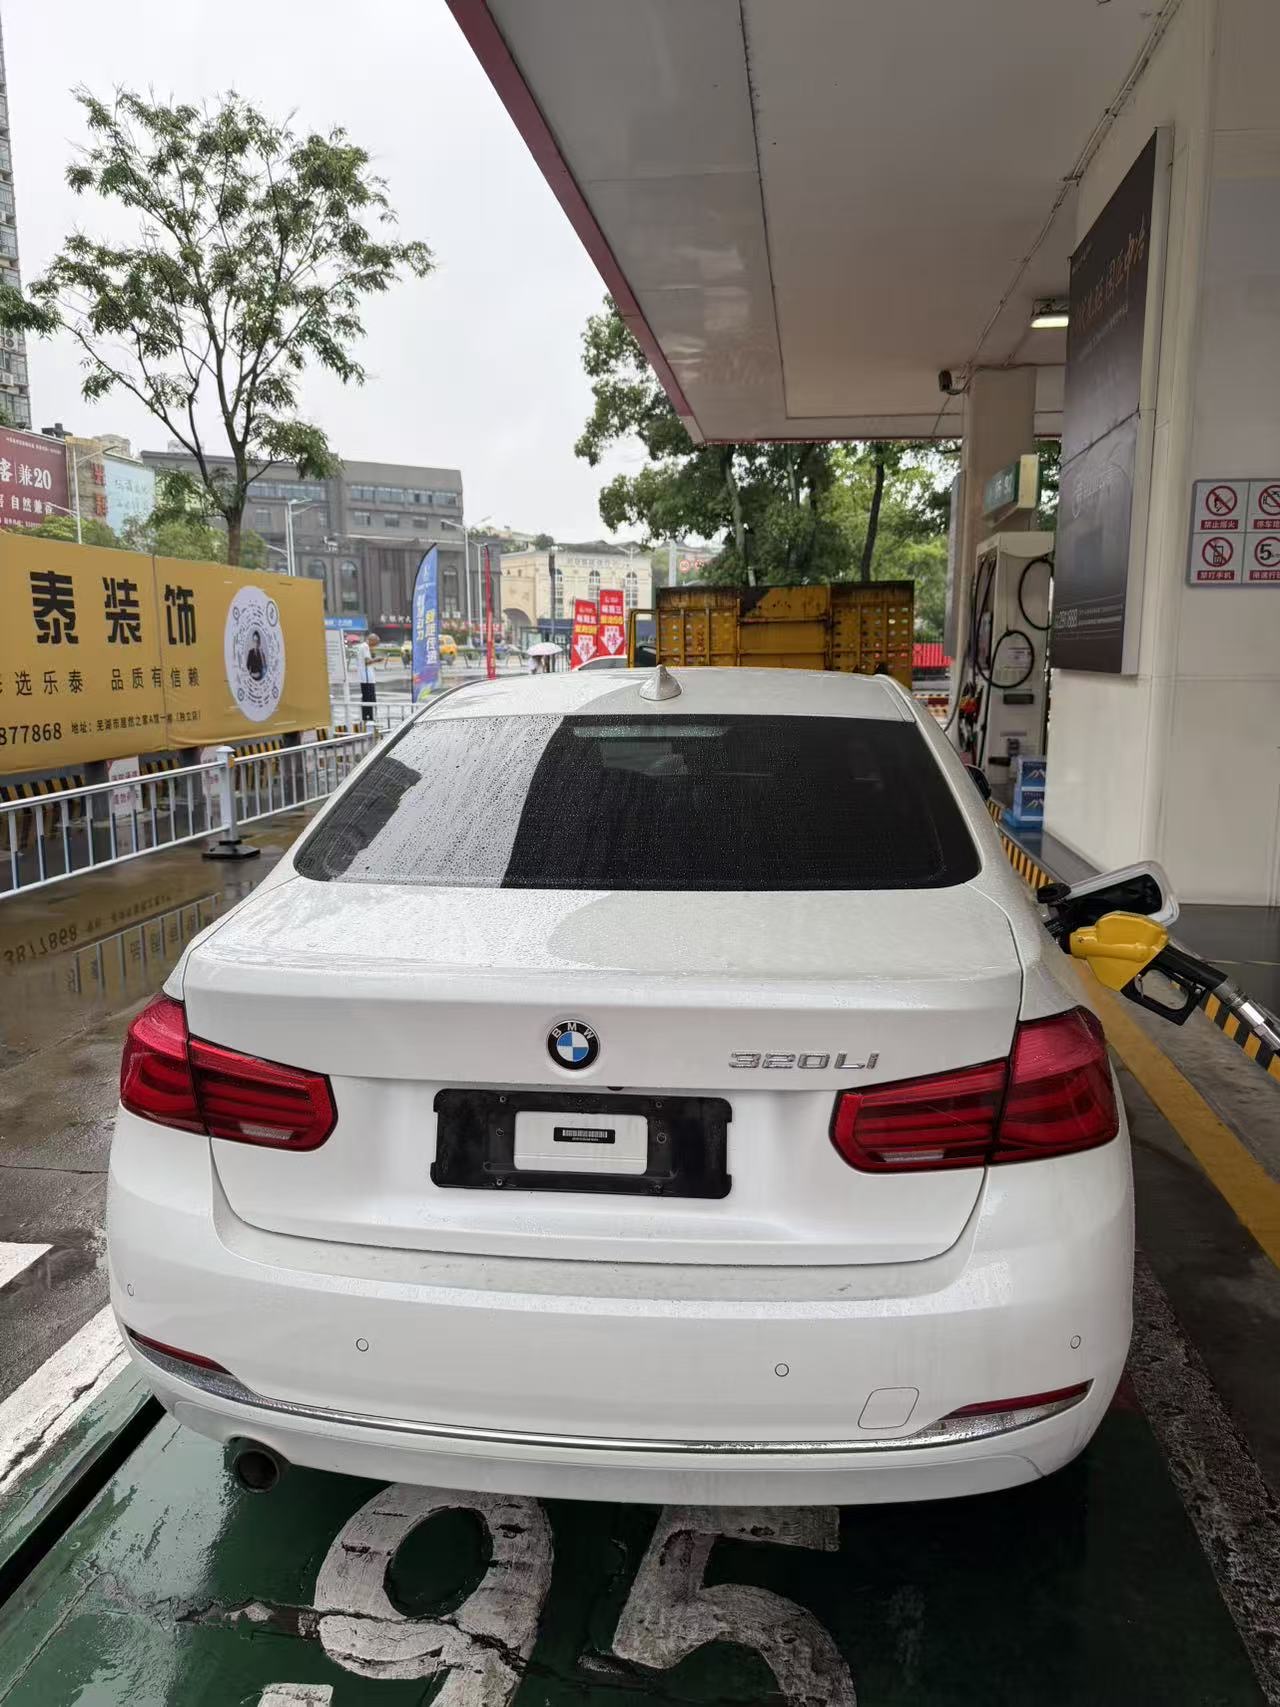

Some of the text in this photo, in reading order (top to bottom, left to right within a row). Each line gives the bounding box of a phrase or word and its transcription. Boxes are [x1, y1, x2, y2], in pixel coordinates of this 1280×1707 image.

[18, 464, 52, 490] 兼20
[30, 570, 197, 646] 泰装饰
[0, 667, 200, 697] 选乐泰 品质有信赖
[0, 722, 62, 746] 877868
[551, 1022, 595, 1039] BMW
